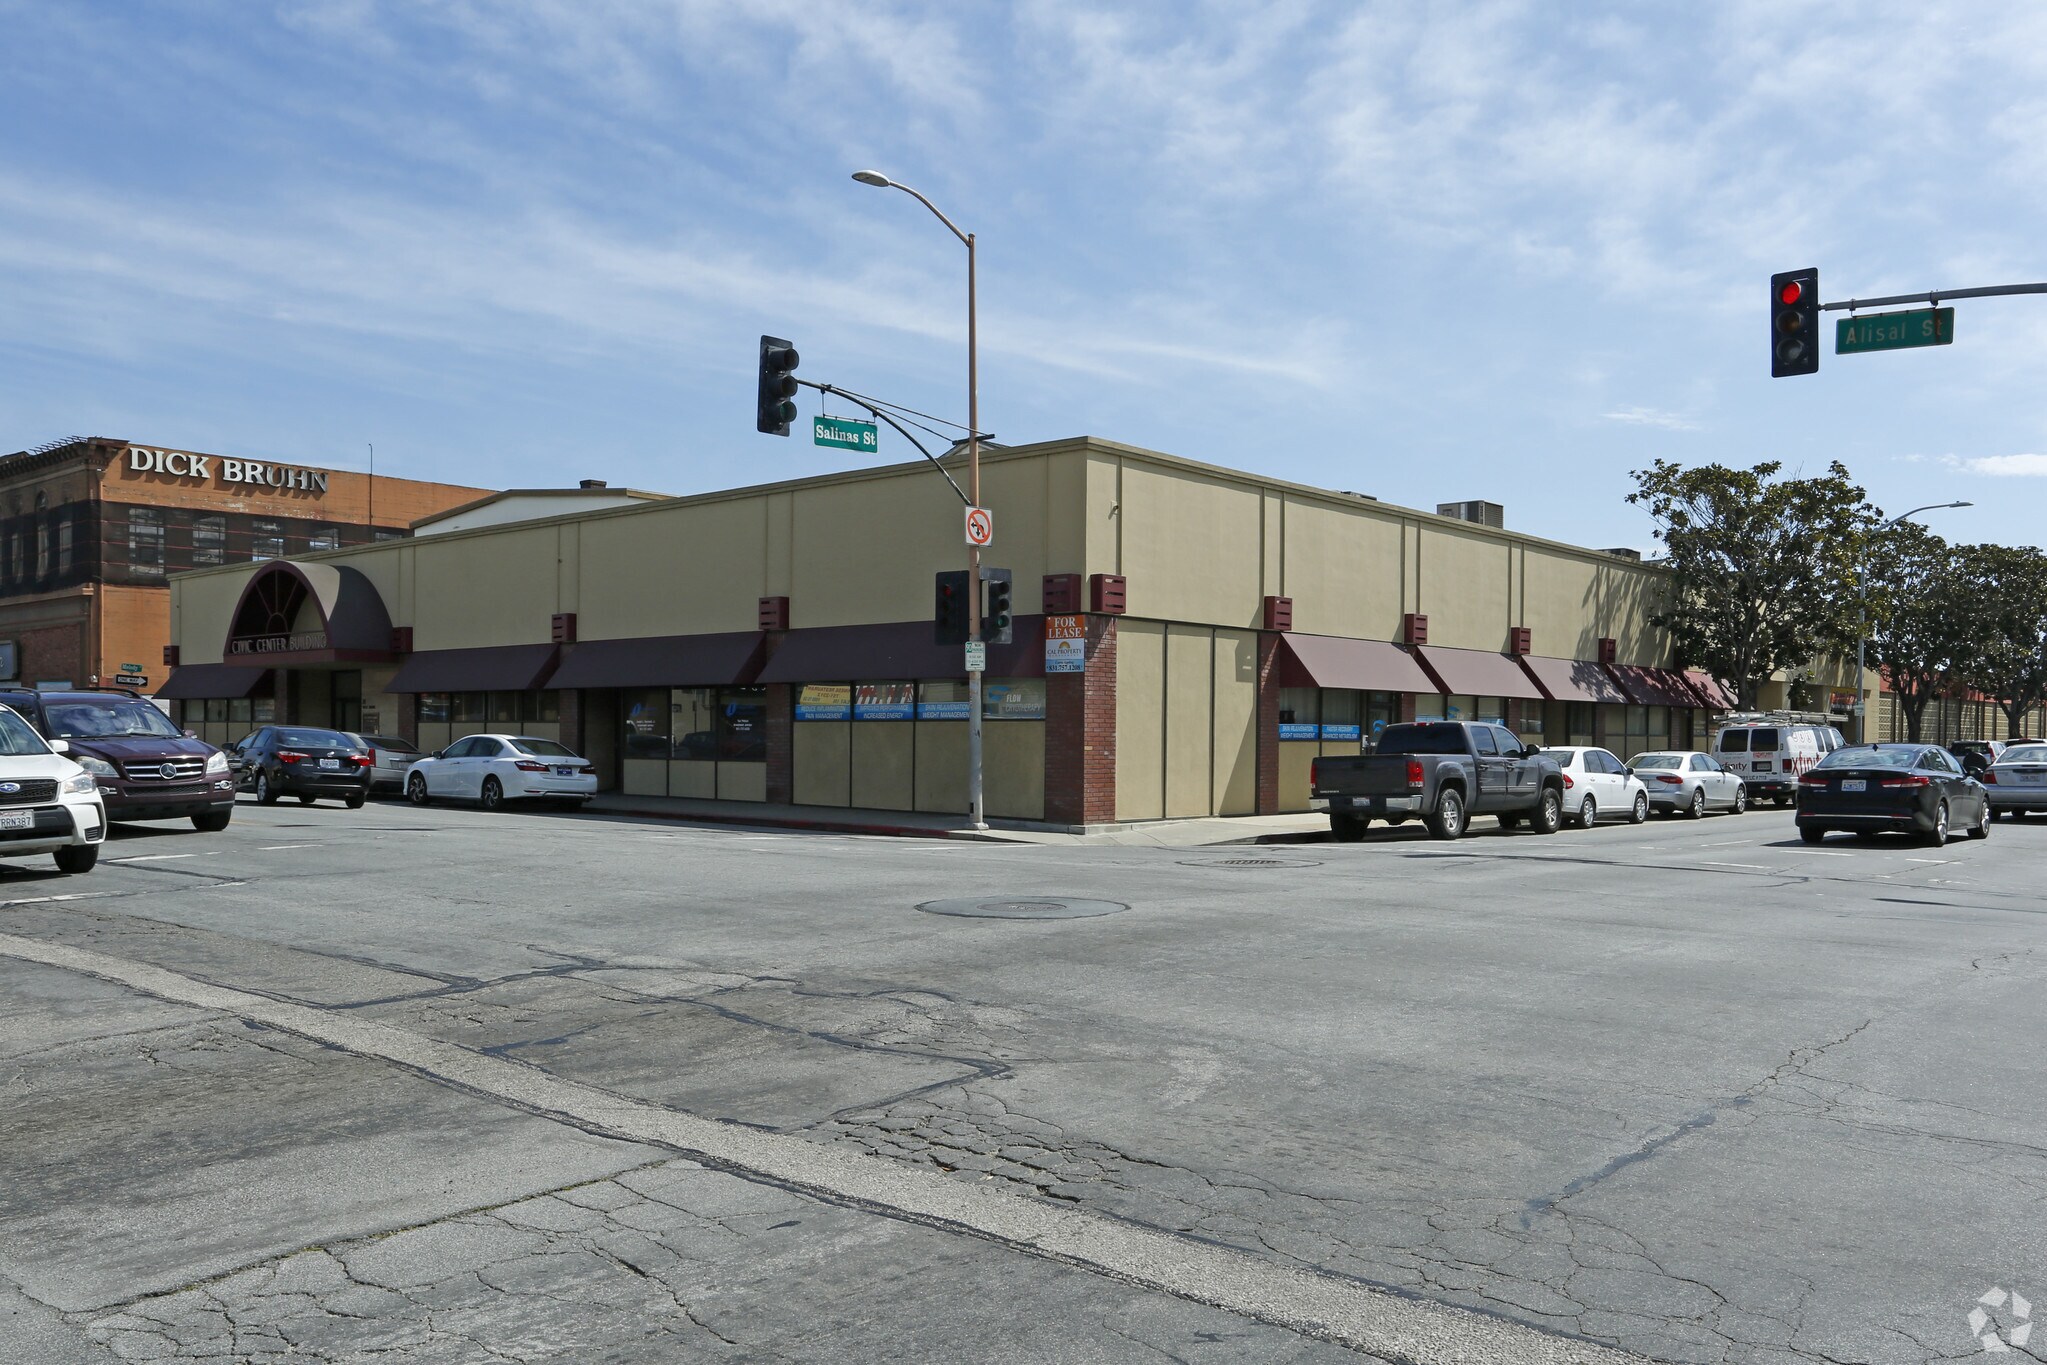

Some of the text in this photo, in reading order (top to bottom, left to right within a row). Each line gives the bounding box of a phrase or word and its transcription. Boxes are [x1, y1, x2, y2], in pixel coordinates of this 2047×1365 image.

[1845, 318, 1943, 345] Alisal St
[816, 424, 876, 446] Salinas St
[129, 447, 329, 493] DICK BRUHN
[1054, 616, 1076, 628] FOR
[1048, 627, 1082, 639] LEASE
[231, 634, 327, 654] CIVIC CENTER BUILDING
[1006, 693, 1022, 702] FLOW
[940, 711, 970, 719] MANAGEMEN
